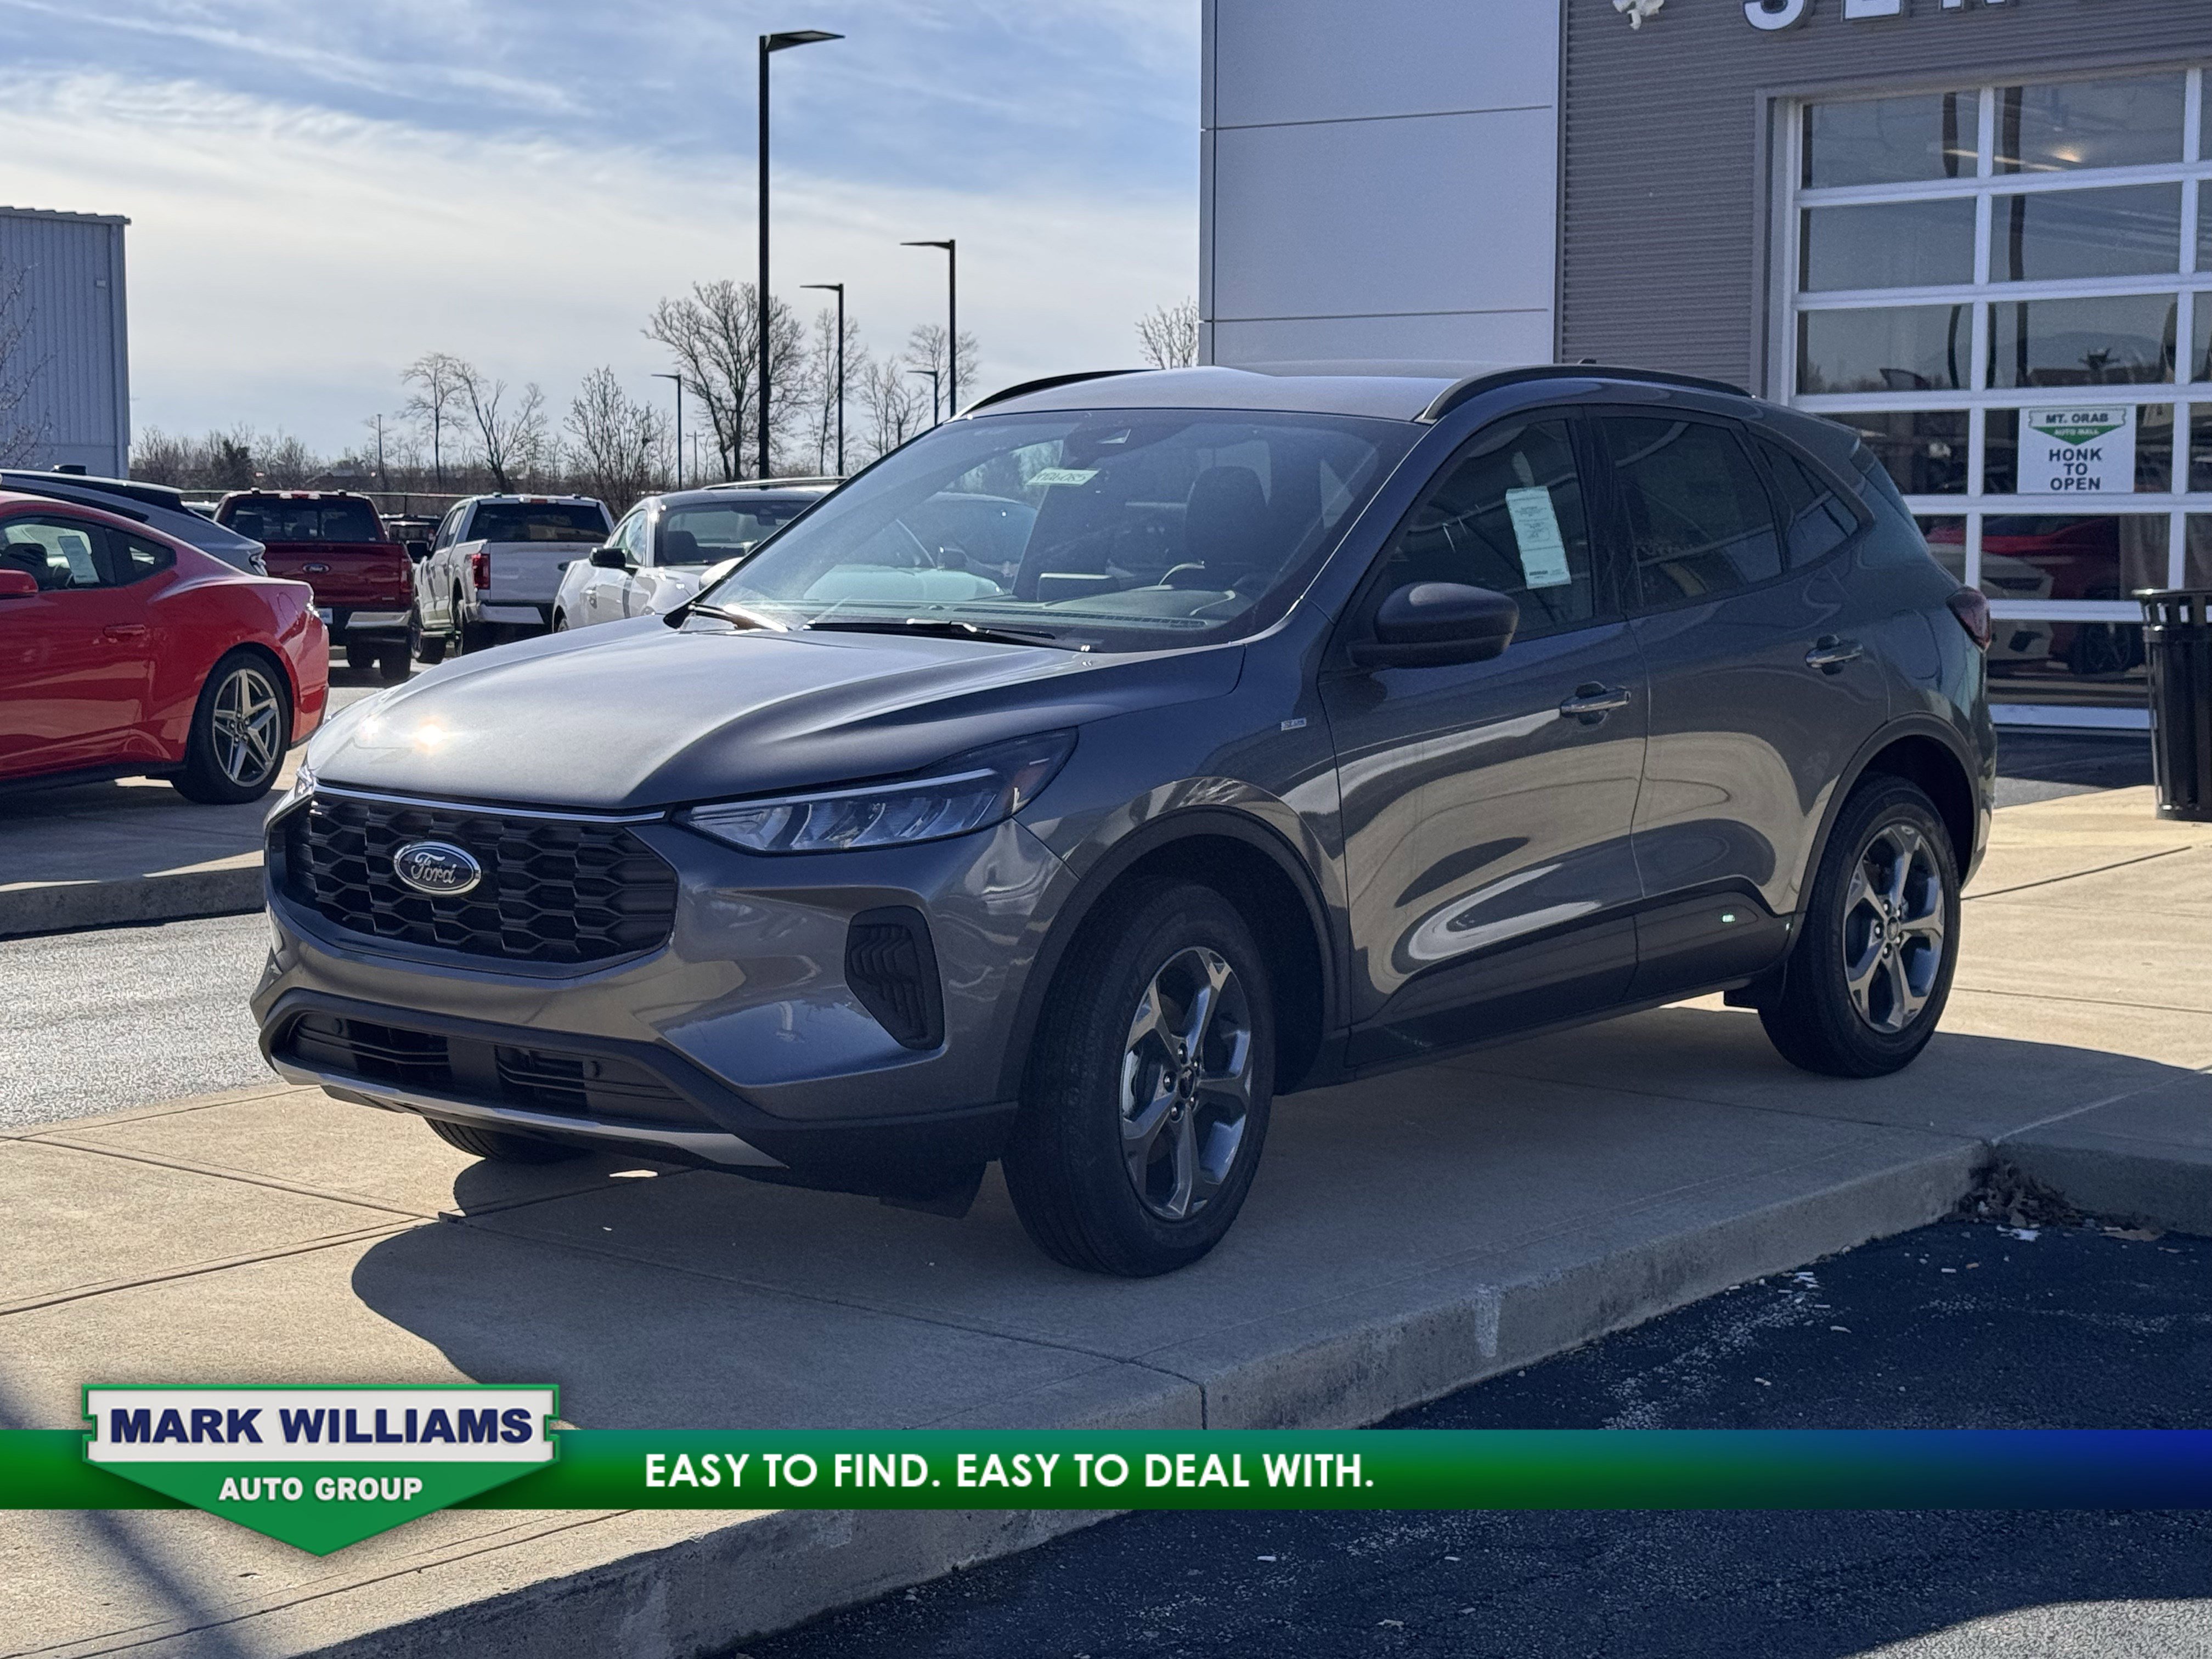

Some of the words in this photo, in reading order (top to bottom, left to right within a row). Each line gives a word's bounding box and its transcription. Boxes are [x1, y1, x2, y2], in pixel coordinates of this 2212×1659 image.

[2046, 414, 2067, 424] MT.
[2072, 413, 2109, 424] ORAB
[2049, 448, 2102, 462] HONK
[2063, 462, 2088, 476] TO
[2050, 477, 2101, 491] OPEN
[411, 851, 457, 883] Ford
